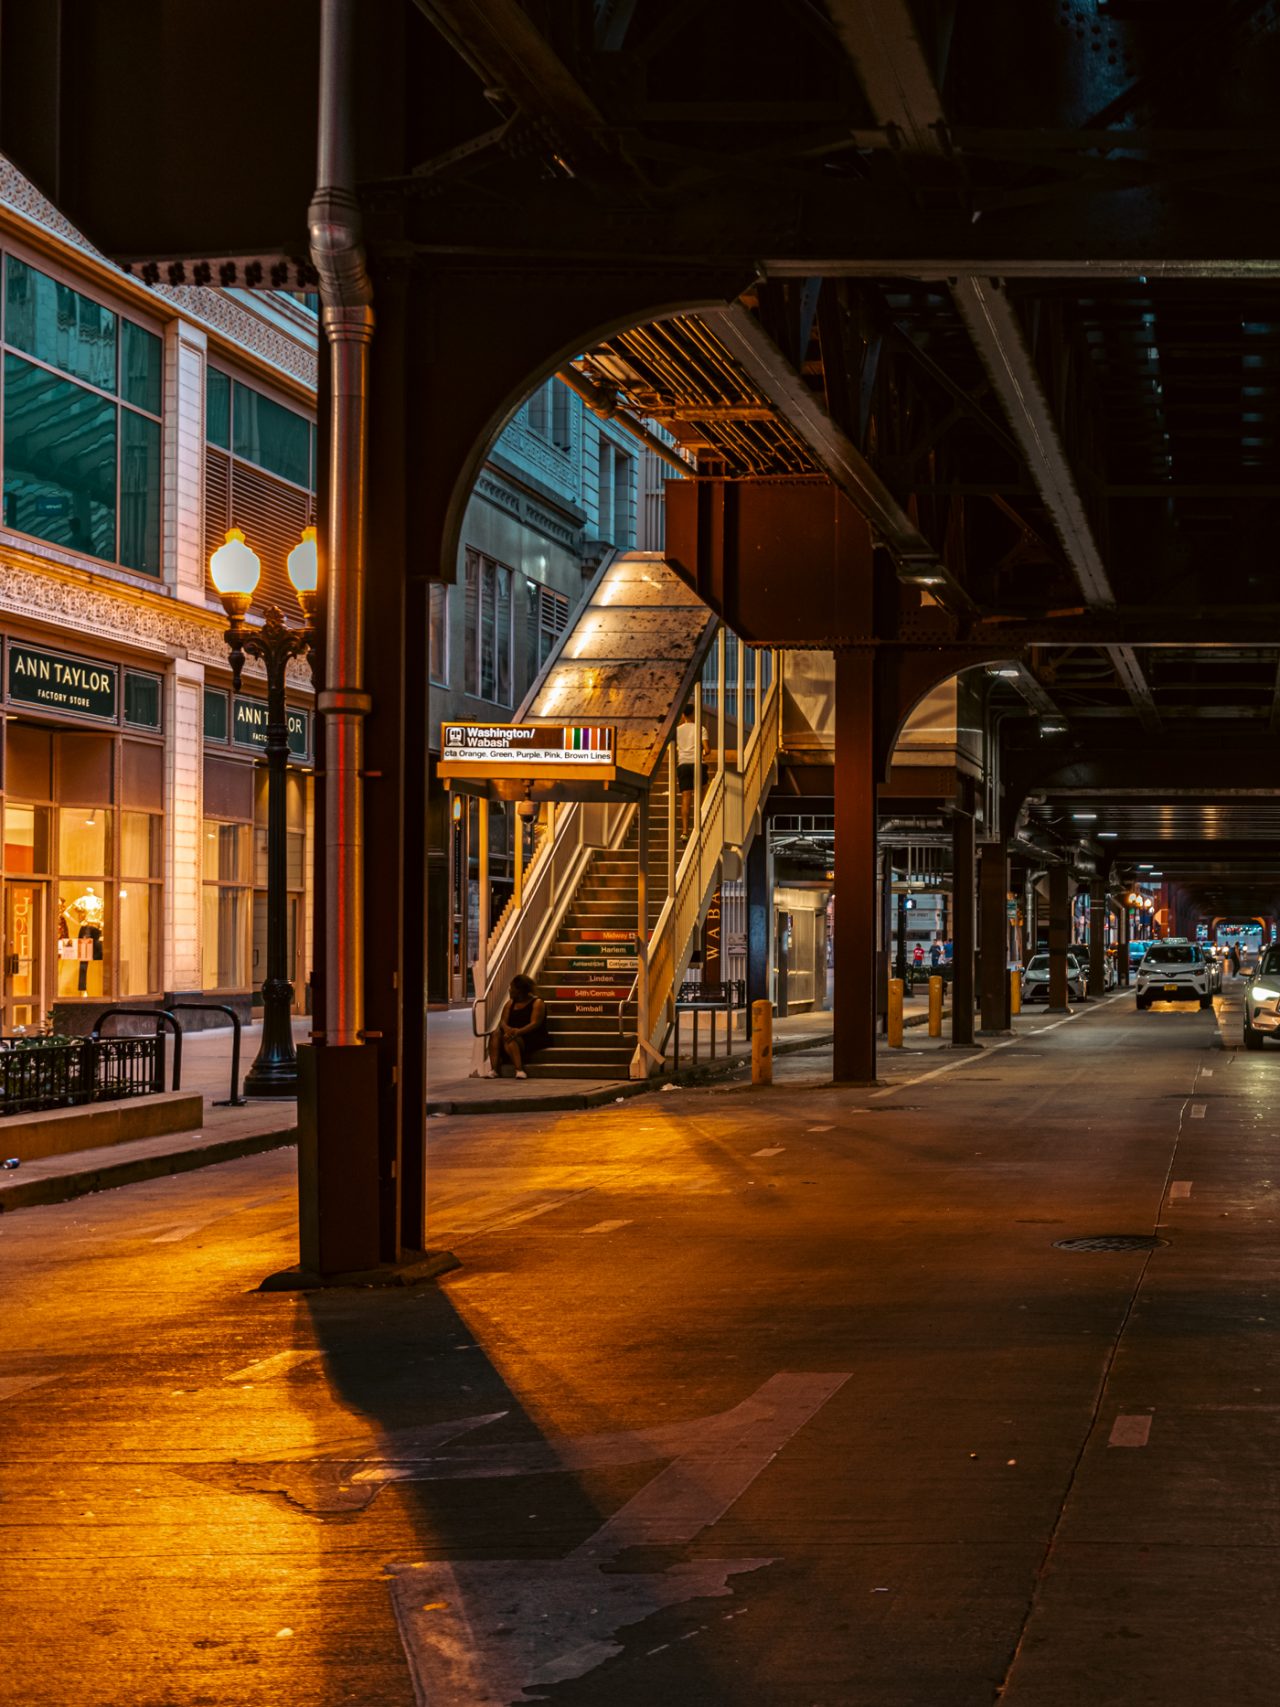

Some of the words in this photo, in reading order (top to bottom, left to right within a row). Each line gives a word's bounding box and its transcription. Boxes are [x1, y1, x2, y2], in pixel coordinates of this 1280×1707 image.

[15, 655, 50, 681] ANN
[54, 664, 110, 694] TAYLOR
[37, 689, 67, 702] FACTORY
[69, 695, 90, 708] STORE
[237, 705, 262, 726] ANN
[466, 727, 536, 741] Washington/
[466, 737, 510, 748] Wabash
[564, 751, 589, 759] Brown
[590, 751, 612, 760] Lines
[603, 931, 627, 940] Midway
[601, 945, 627, 953] Harlem
[590, 974, 614, 982] Linden
[575, 1004, 604, 1013] Kimball
